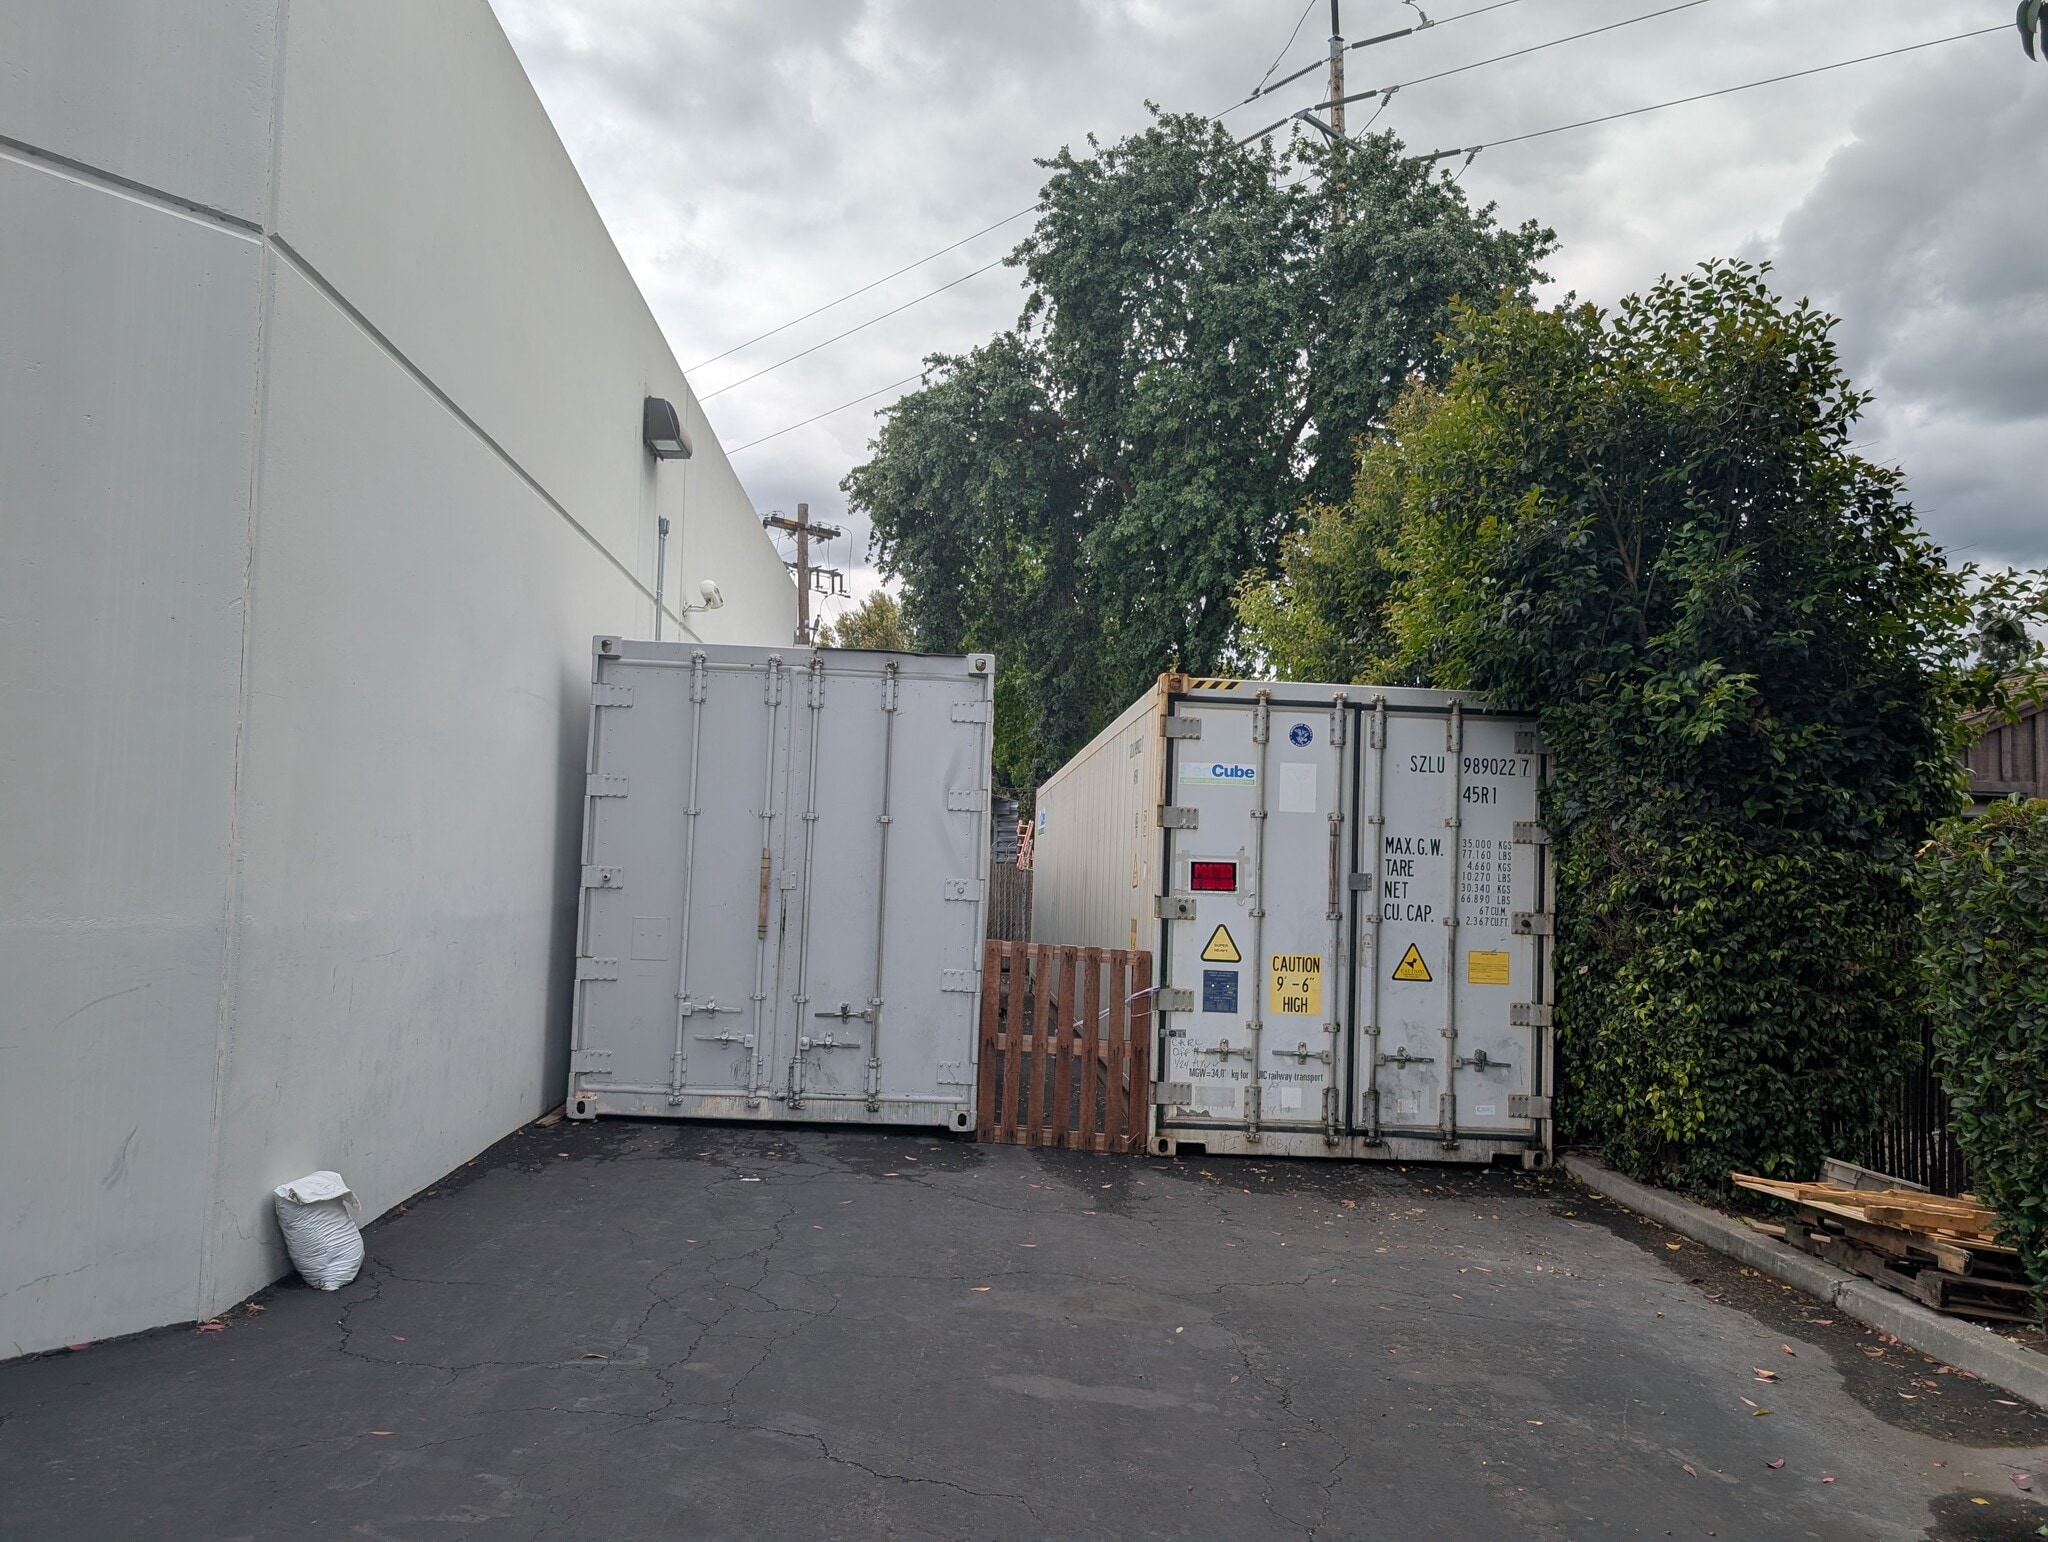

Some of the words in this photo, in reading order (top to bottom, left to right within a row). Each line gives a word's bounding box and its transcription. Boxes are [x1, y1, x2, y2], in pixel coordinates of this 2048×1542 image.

[1410, 755, 1445, 773] SZLU
[1463, 757, 1516, 776] 989022
[1462, 786, 1497, 804] 45R1
[1462, 839, 1492, 849] 35.000
[1498, 840, 1512, 850] KGS
[1462, 849, 1491, 860] 77.160
[1498, 851, 1512, 861] LBS
[1385, 859, 1414, 877] TARE
[1467, 861, 1491, 871] 4.660
[1497, 862, 1512, 872] KGS
[1462, 872, 1491, 882] 10.270
[1497, 873, 1511, 883] LBS
[1384, 881, 1409, 899] NET
[1461, 883, 1490, 894] 30.340
[1497, 884, 1511, 894] KGS
[1460, 894, 1490, 904] 66.890
[1497, 895, 1511, 905] LBS
[1384, 903, 1403, 921] CU.
[1407, 904, 1434, 923] CAP.
[1479, 906, 1489, 916] 67
[1465, 916, 1489, 926] 2.367
[1272, 955, 1320, 973] CAUTION
[1282, 996, 1308, 1013] HIGH
[1231, 1069, 1239, 1081] kg
[1240, 1069, 1249, 1079] for
[1268, 1070, 1293, 1082] railway
[1293, 1072, 1324, 1083] transport
